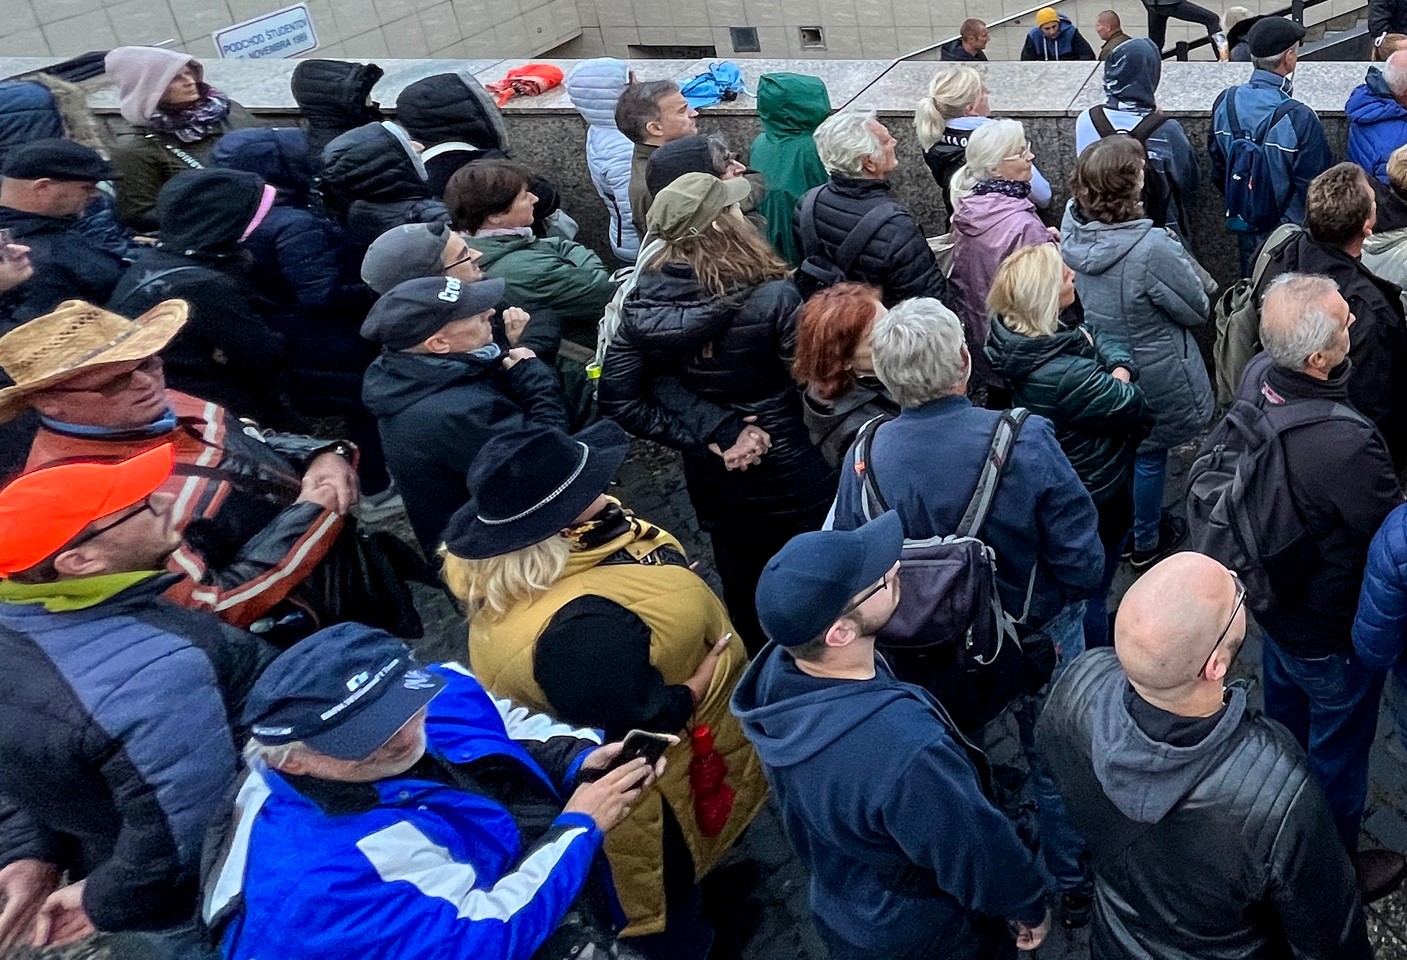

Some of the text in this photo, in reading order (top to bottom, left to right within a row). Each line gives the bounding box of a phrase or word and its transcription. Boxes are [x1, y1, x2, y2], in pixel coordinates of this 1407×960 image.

[224, 18, 307, 54] PODCHOD ŠTUDENTOV
[249, 39, 291, 58] NOVEMBRA
